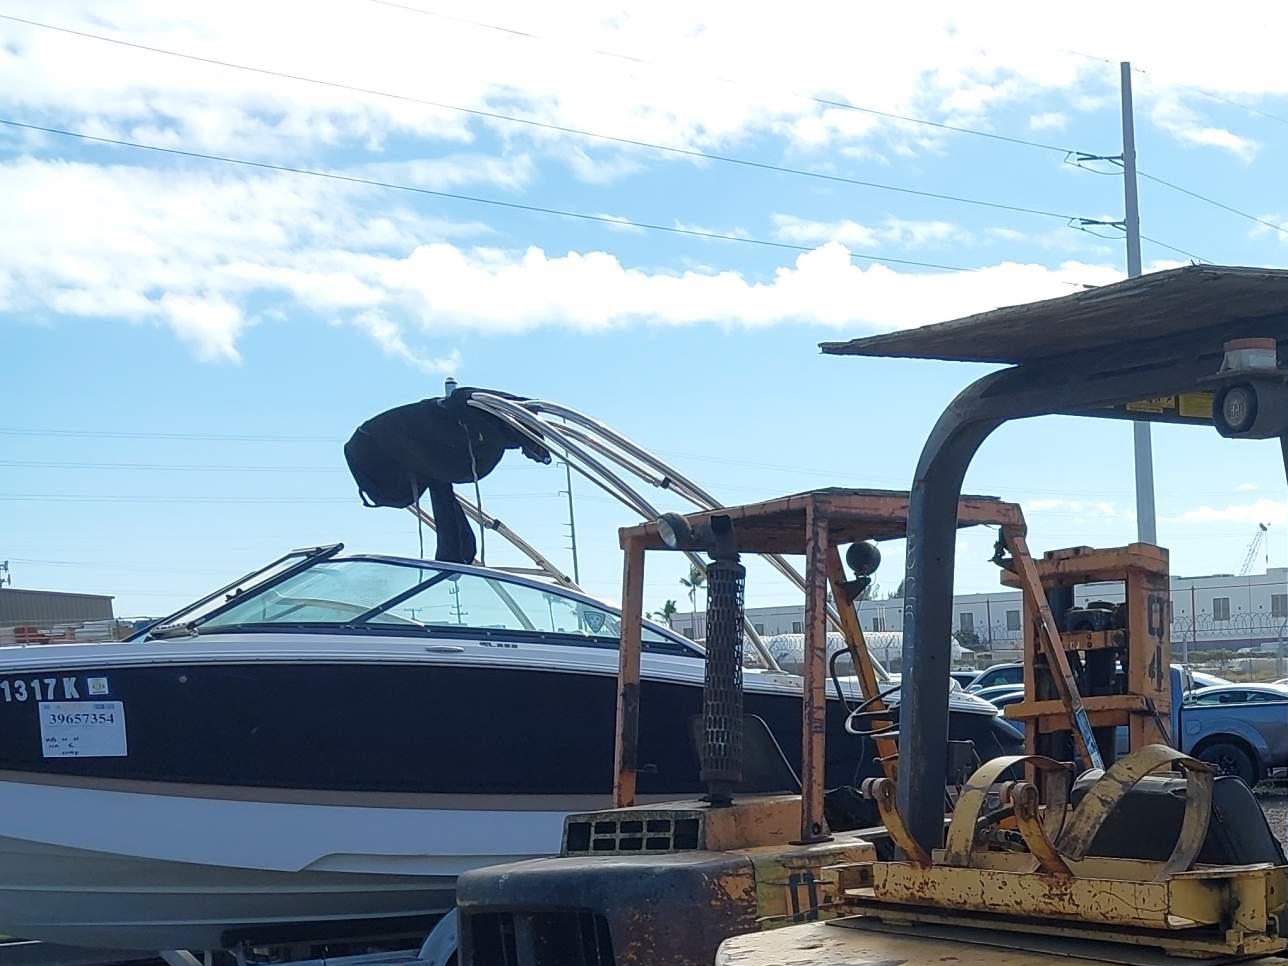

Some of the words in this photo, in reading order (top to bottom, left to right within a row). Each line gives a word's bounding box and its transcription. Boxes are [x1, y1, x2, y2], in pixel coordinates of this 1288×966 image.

[0, 678, 56, 702] 1317
[63, 677, 80, 699] K
[49, 712, 115, 725] 39657354
